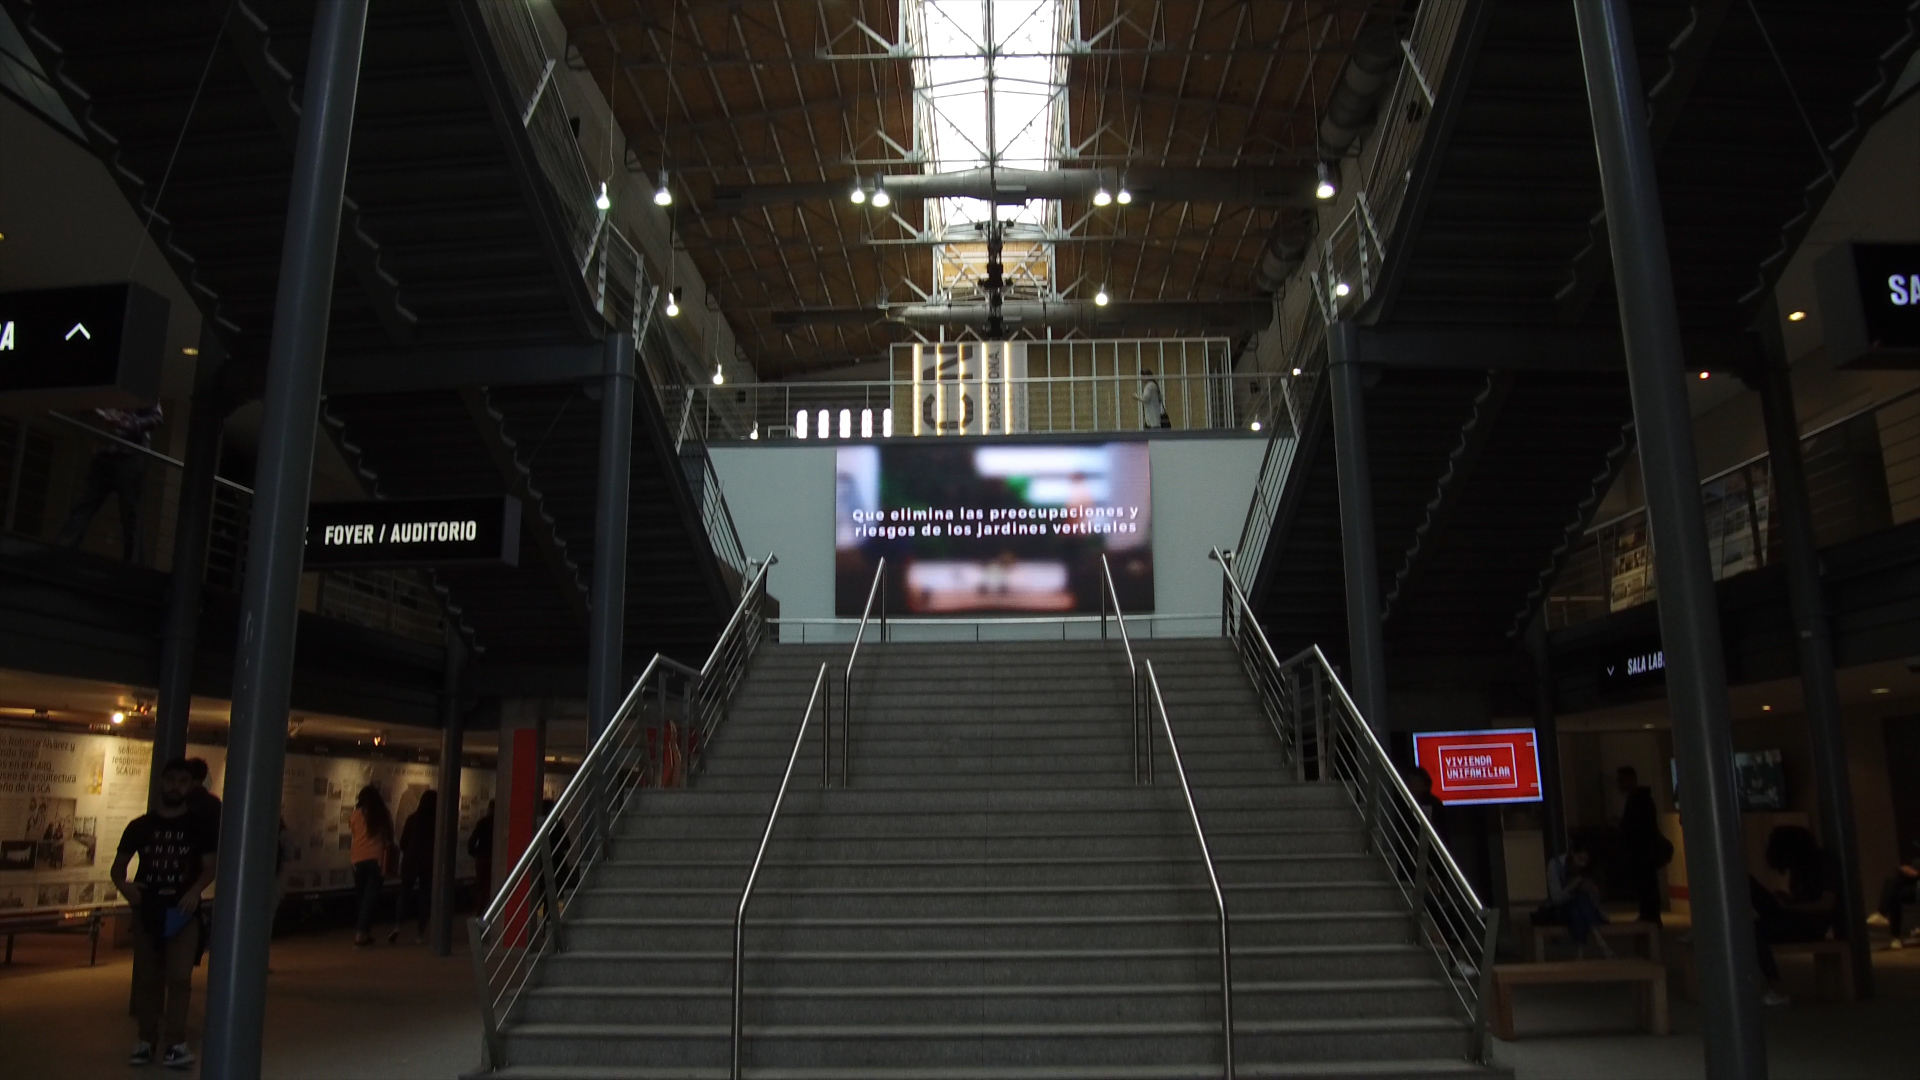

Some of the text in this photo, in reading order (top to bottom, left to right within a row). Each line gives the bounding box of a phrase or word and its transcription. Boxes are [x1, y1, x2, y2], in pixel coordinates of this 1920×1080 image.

[0, 320, 15, 351] A
[852, 504, 1139, 523] Que elimina las preocupaciones y
[324, 524, 374, 545] FOYER
[390, 520, 477, 543] AUDITORIO
[855, 520, 1137, 539] riesgos de los jardines verticales
[1627, 650, 1666, 676] SALA LAB
[1445, 754, 1493, 767] VIVIENDA
[1446, 765, 1511, 779] UNIFAMILIAR
[154, 830, 184, 841] YOU
[144, 844, 190, 855] KNOW
[152, 859, 180, 869] HIS
[146, 873, 184, 883] NAME
